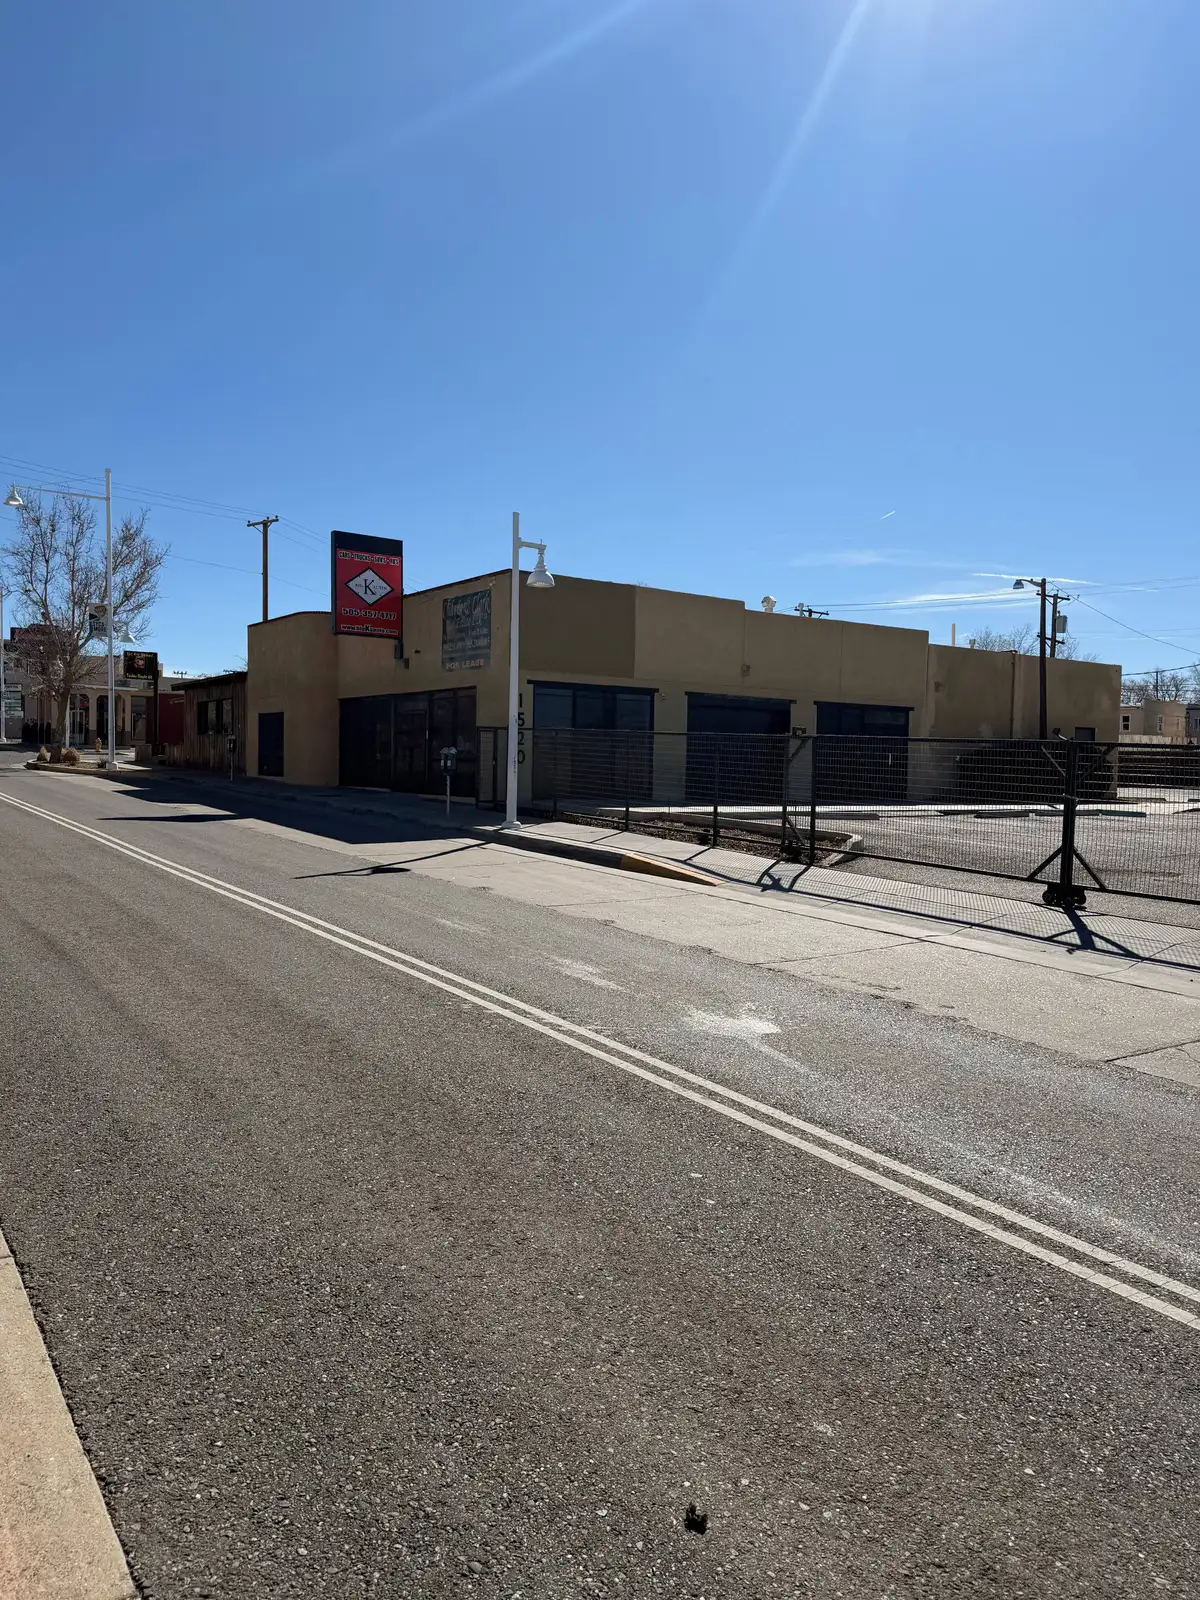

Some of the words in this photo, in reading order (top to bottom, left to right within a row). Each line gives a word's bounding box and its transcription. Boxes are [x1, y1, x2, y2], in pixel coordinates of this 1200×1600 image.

[339, 551, 351, 559] CARS
[354, 553, 371, 562] TRUCKS
[363, 579, 376, 595] K
[446, 661, 460, 669] FOR
[462, 659, 484, 668] LEASE
